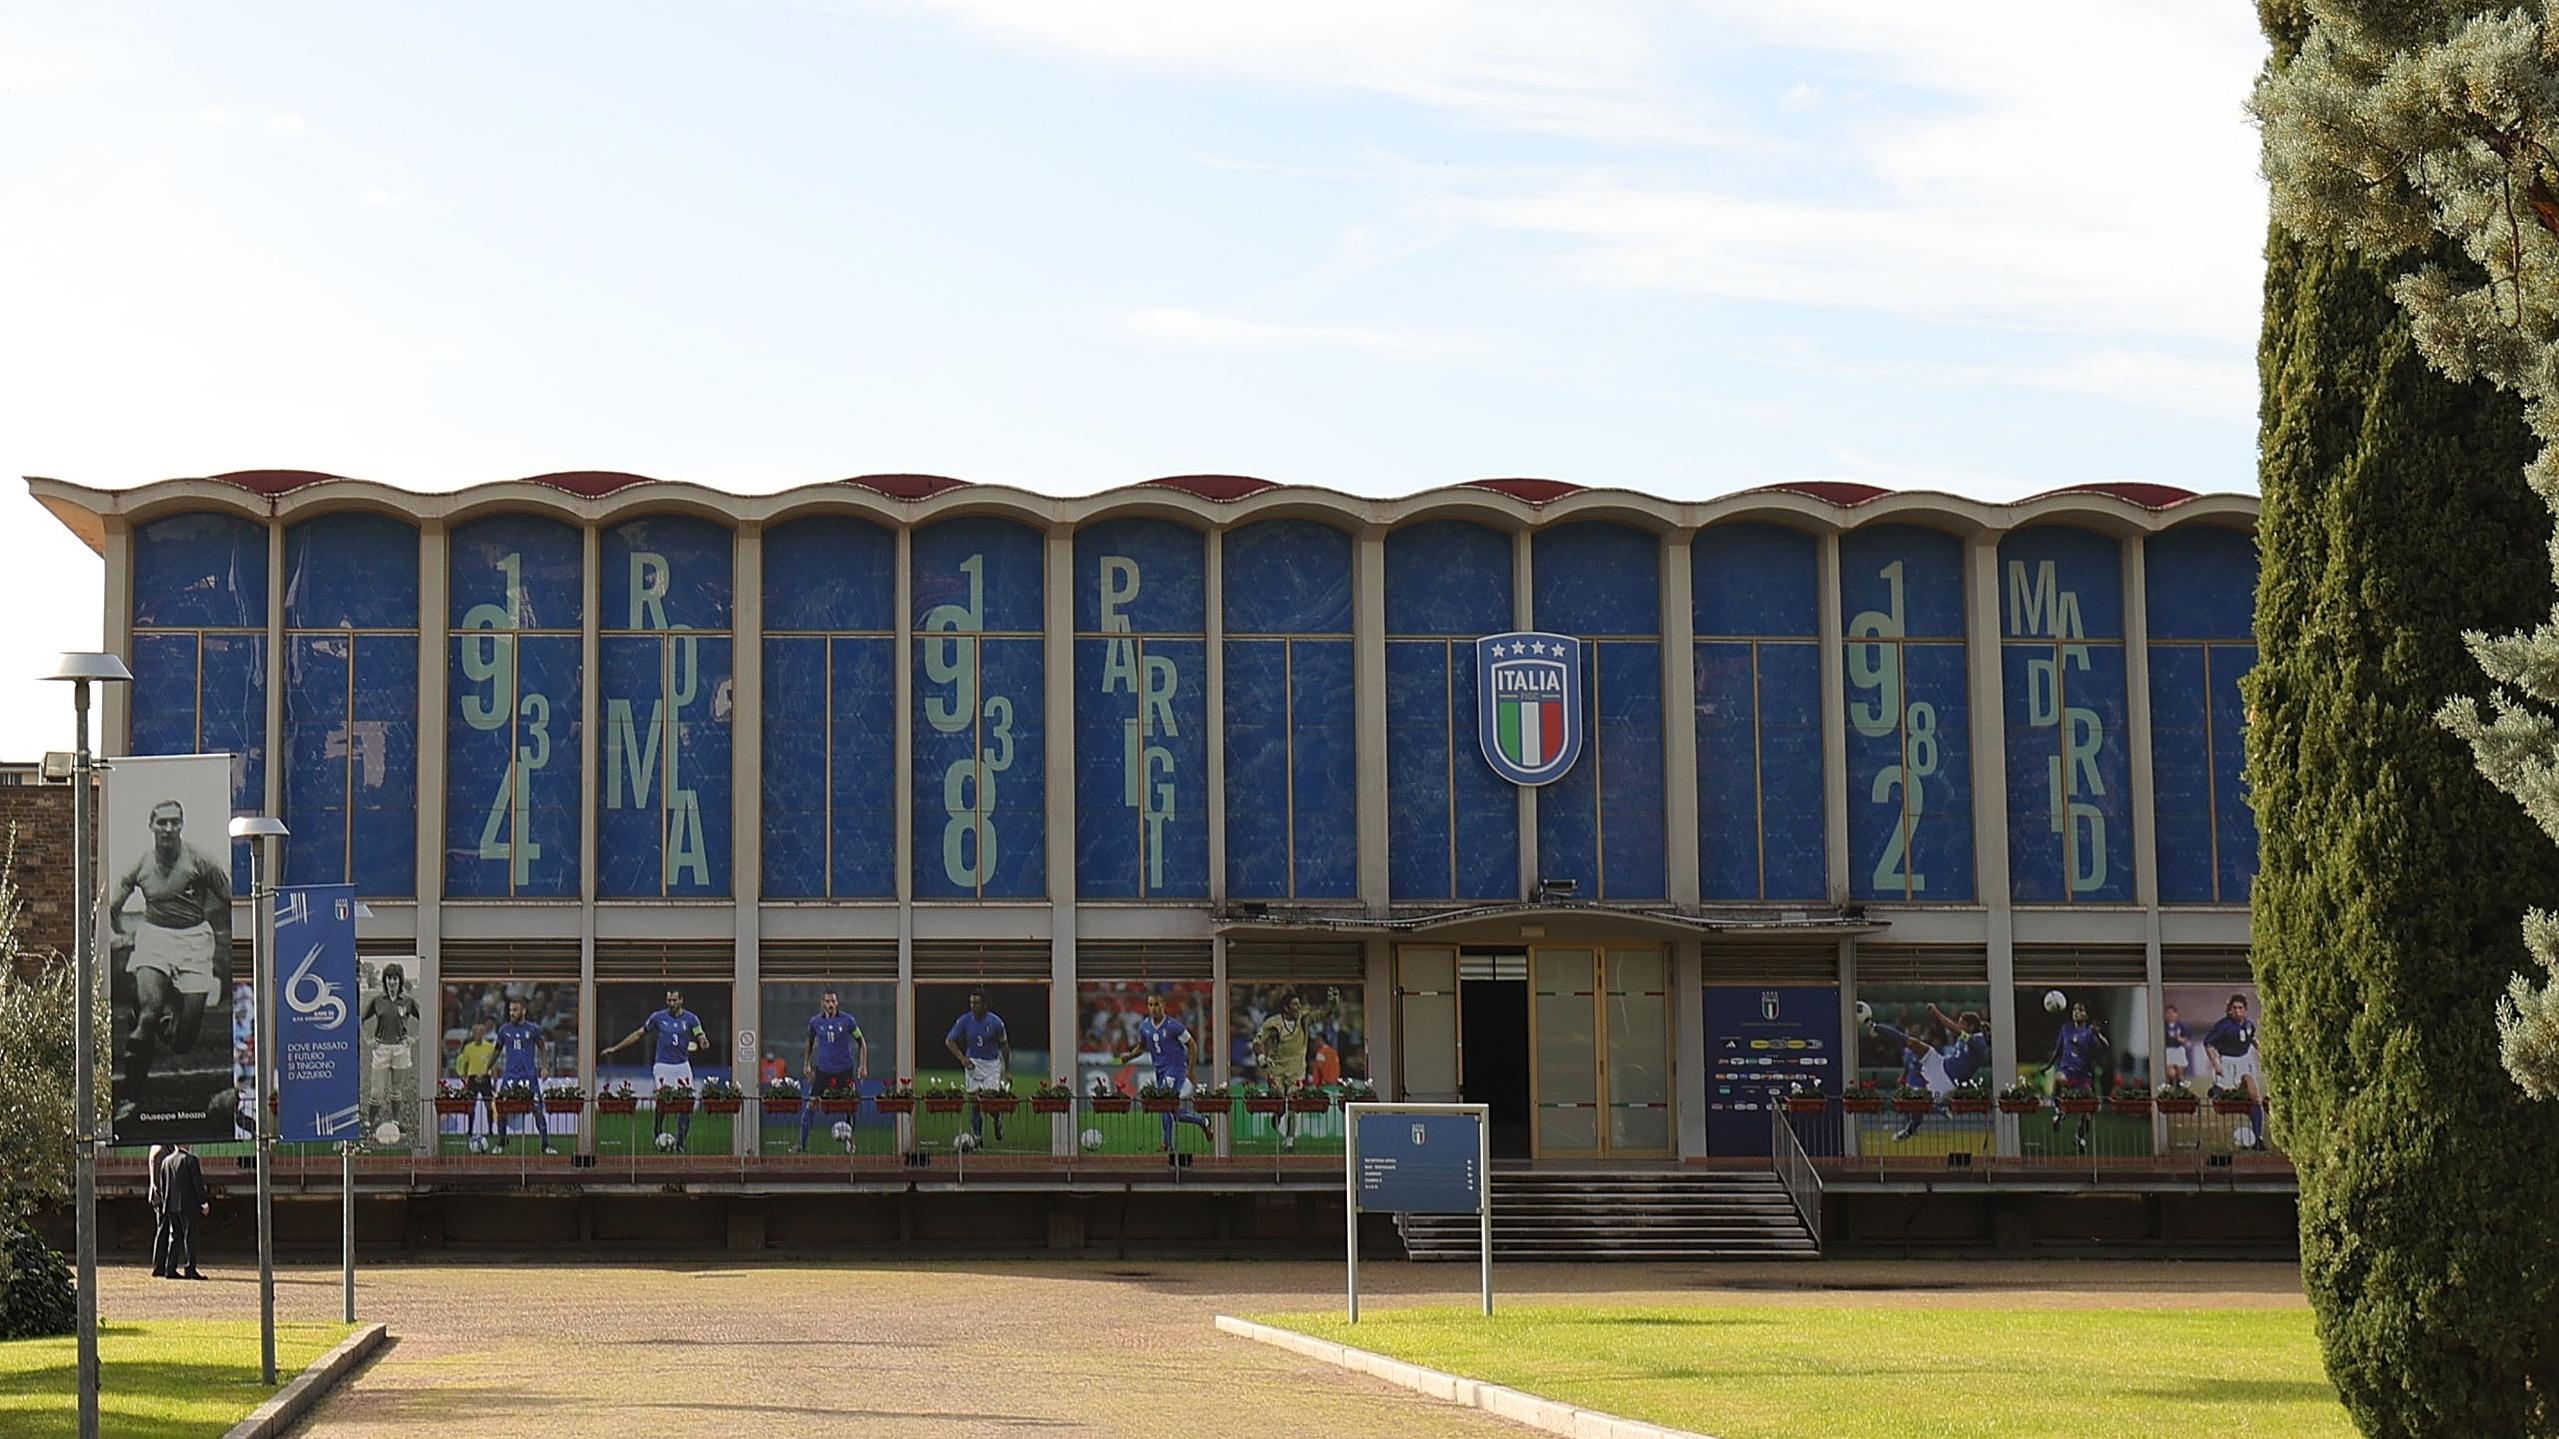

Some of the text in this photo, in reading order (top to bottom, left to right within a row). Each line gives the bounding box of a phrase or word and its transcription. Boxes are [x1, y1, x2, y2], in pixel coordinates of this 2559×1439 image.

[1498, 670, 1561, 691] ITALIA
[607, 552, 710, 885] ROMA
[285, 942, 347, 1031] 65
[287, 1041, 348, 1052] DOVE PASSATO
[288, 1052, 325, 1061] E FUTURO
[288, 1060, 335, 1071] SI TINGONO
[140, 1111, 206, 1121] Giuseppe Meazza
